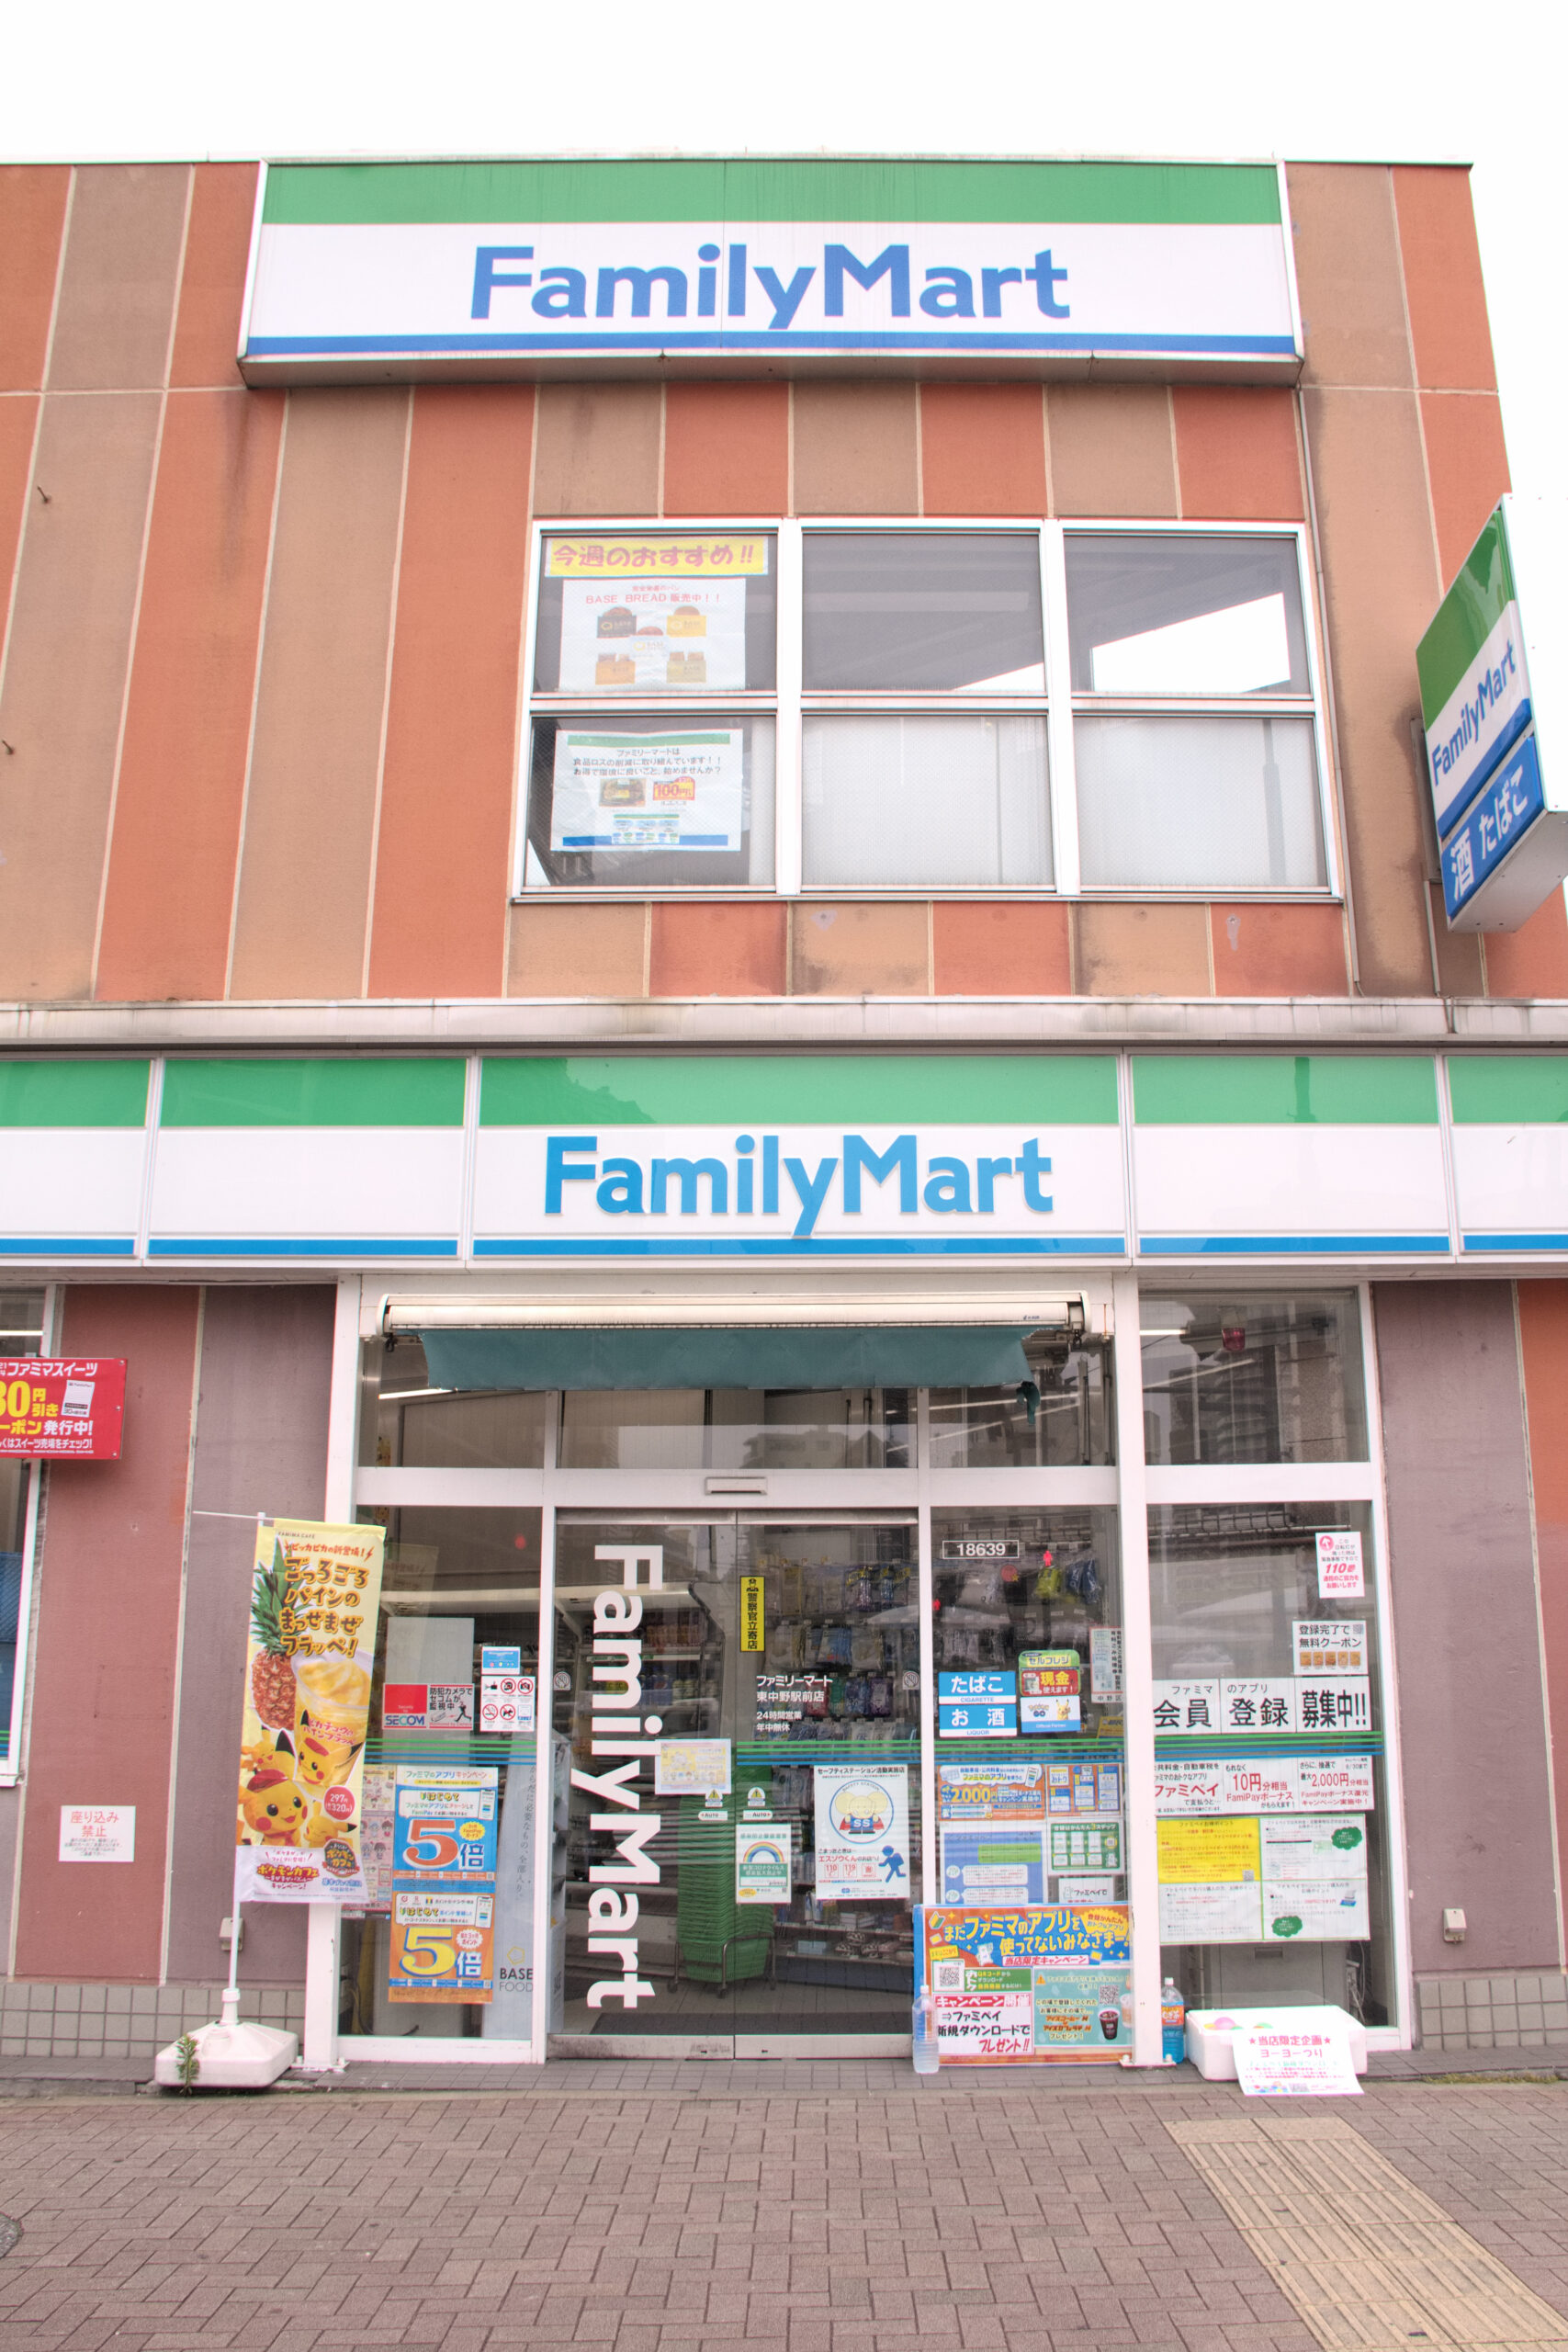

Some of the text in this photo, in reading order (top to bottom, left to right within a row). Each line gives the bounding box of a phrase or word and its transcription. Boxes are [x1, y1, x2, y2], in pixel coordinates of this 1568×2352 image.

[469, 243, 1071, 329] FamilyMart
[553, 545, 754, 567] 今週のおすすめ!!
[585, 594, 618, 605] BASE
[625, 594, 667, 603] BREAD
[1432, 639, 1517, 787] FamilyMart
[616, 748, 682, 757] ファミリーマートは
[1450, 764, 1529, 901] 酒 たばこ
[545, 1134, 1055, 1238] FamilyMart
[7, 1362, 98, 1376] ファミマスイーツ
[43, 1419, 94, 1435] 発行中!
[956, 1543, 1006, 1556] 18639
[284, 1585, 360, 1609] パインの
[279, 1606, 364, 1635] まっぜまぜ
[747, 1592, 758, 1650] 警察官立寄店
[1299, 1624, 1350, 1635] 登録完了で
[1299, 1638, 1361, 1648] 無料クーポン
[1028, 1655, 1070, 1666] セルフレジ
[756, 1675, 833, 1687] ファミリーマート
[1040, 1670, 1070, 1686] 現金
[951, 1675, 1004, 1694] たばこ
[1043, 1686, 1074, 1694] 使えます！
[1172, 1683, 1269, 1694] ファミマ のアプリ
[429, 1687, 472, 1696] 防犯カメラで
[756, 1690, 825, 1702] 東中野駅前店
[429, 1702, 456, 1712] 監視中
[756, 1711, 802, 1721] 24時間営業
[1153, 1699, 1213, 1728] 会員
[1228, 1698, 1289, 1727] 登録
[385, 1715, 425, 1726] SECOM
[756, 1723, 790, 1733] 年中無休
[1300, 1760, 1336, 1770] さらに、抽選で
[570, 1544, 663, 2009] FamilyMart
[818, 1767, 905, 1775] セーフティステーション活動実施店
[1155, 1783, 1219, 1798] ファミペイ
[426, 1792, 459, 1802] はじめて
[1226, 1792, 1293, 1803] FamiPayボーナス
[71, 1811, 119, 1824] 座り込み
[852, 1818, 871, 1828] SS
[82, 1826, 107, 1837] 禁止
[402, 1819, 485, 1871] 5倍
[256, 1863, 321, 1878] ポケモンカフェ
[825, 1864, 839, 1872] 110
[1073, 1888, 1108, 1896] ファミペイで
[406, 1907, 439, 1917] はじめて
[944, 1909, 1081, 1942] まだファミマのアプリを
[400, 1927, 482, 1979] 5倍
[1004, 1956, 1089, 1965] 当店限定キャンペーン
[500, 1968, 533, 1980] BASE
[499, 1982, 533, 1992] FOOD
[936, 1995, 1030, 2007] キャンペーン開催
[952, 2011, 1002, 2021] ファミペイ
[937, 2024, 1031, 2037] 新規ダウンロードで
[1258, 2035, 1323, 2046] 当店限定企画
[1260, 2049, 1324, 2059] ヨーヨーつり
